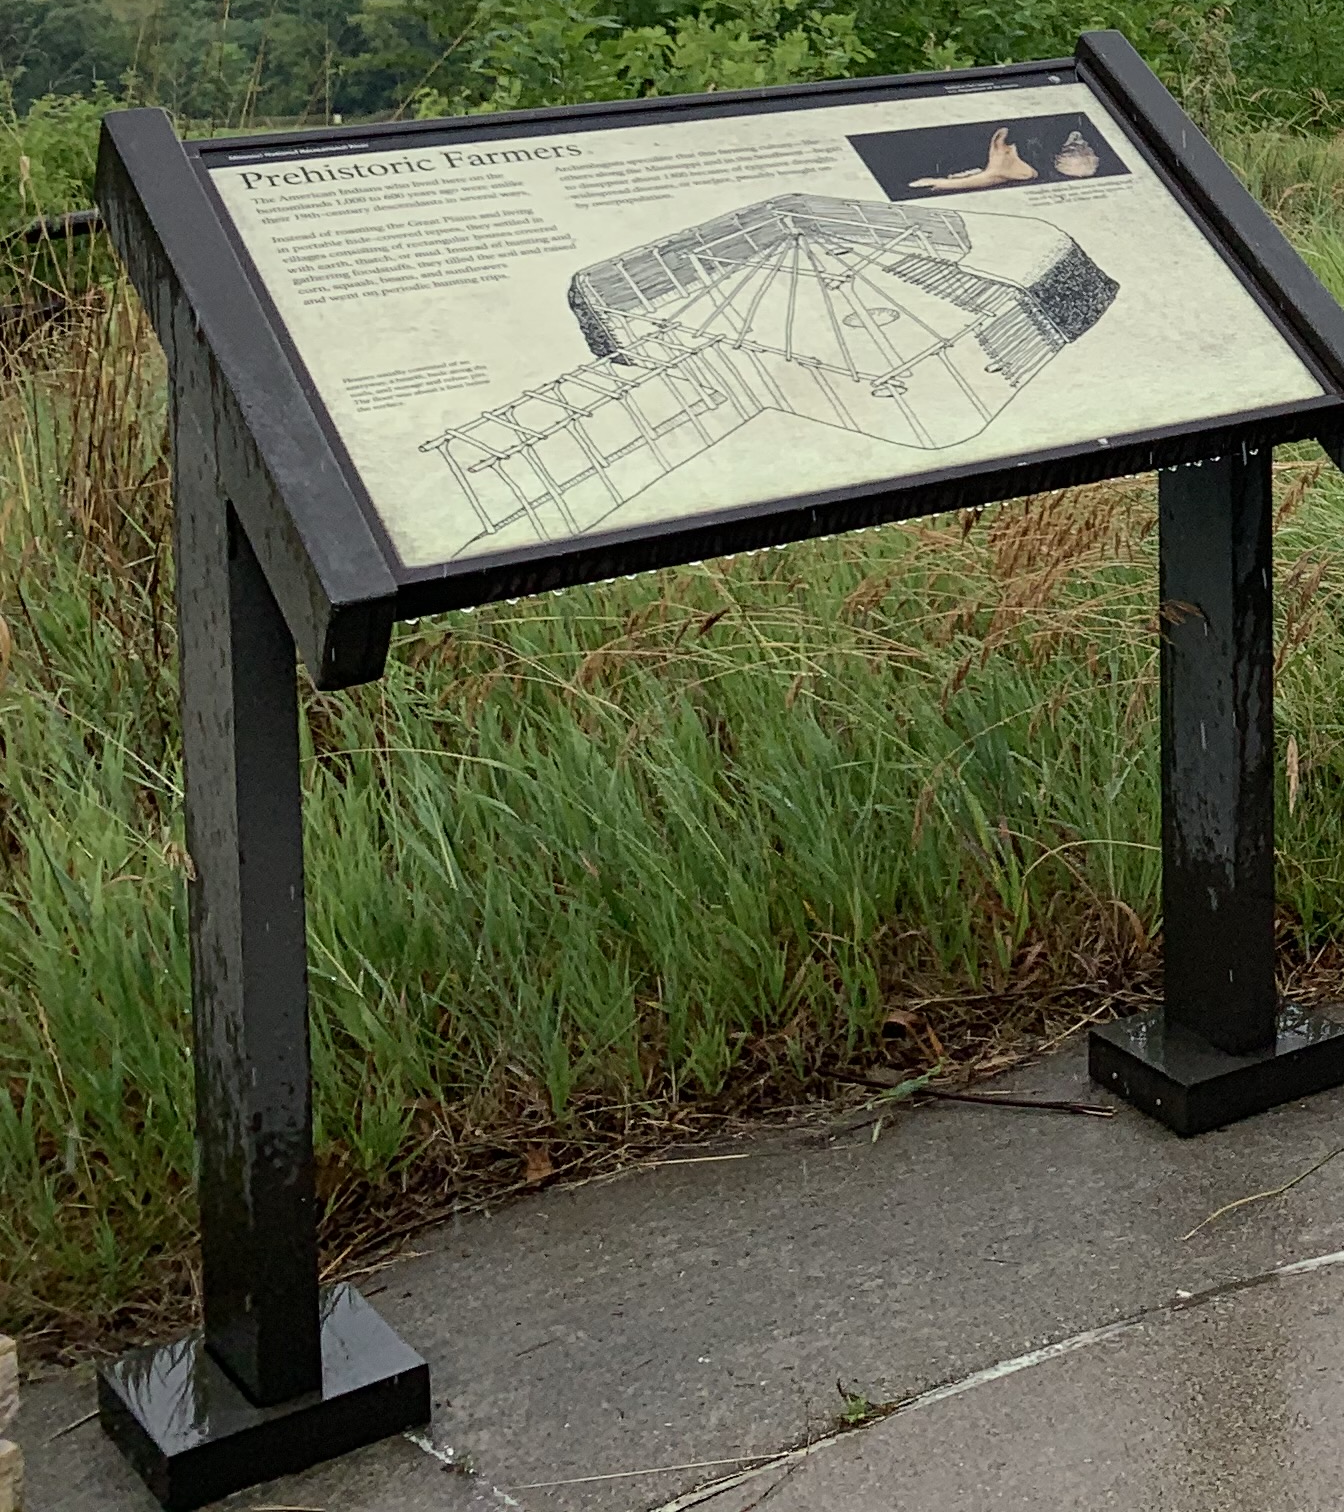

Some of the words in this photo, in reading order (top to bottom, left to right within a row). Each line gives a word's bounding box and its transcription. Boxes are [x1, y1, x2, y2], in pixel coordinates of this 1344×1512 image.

[238, 156, 435, 190] Prehistoric
[440, 144, 582, 170] Farmers
[250, 197, 275, 205] The
[278, 192, 337, 202] American
[338, 187, 383, 195] Indians
[411, 179, 440, 187] lived
[255, 201, 333, 214] bottomlands
[407, 191, 437, 200] years
[489, 181, 524, 189] unlike
[372, 200, 444, 212] descendants
[460, 193, 498, 202] several
[271, 233, 317, 243] Instead
[335, 227, 386, 236] roaming
[406, 219, 440, 228] Great
[442, 216, 478, 224] Plains
[479, 211, 501, 219] and
[292, 241, 344, 254] portable
[493, 218, 530, 228] settled
[282, 255, 327, 264] villages
[328, 247, 391, 258] consisting
[391, 243, 404, 251] of
[406, 237, 471, 249] rectangular
[472, 232, 513, 241] houses
[514, 225, 559, 236] covered
[287, 265, 315, 274] with
[317, 260, 354, 270] earth,
[446, 244, 489, 254] Instead
[505, 238, 551, 247] hunting
[550, 233, 573, 242] and
[292, 273, 351, 286] gathering
[444, 256, 475, 265] tilled
[497, 250, 518, 258] soil
[520, 247, 542, 256] and
[298, 287, 331, 295] corn,
[379, 276, 419, 284] beans,
[420, 270, 443, 279] and
[303, 296, 327, 305] and
[329, 293, 360, 302] went
[381, 284, 431, 297] periodic
[432, 279, 480, 288] hunting
